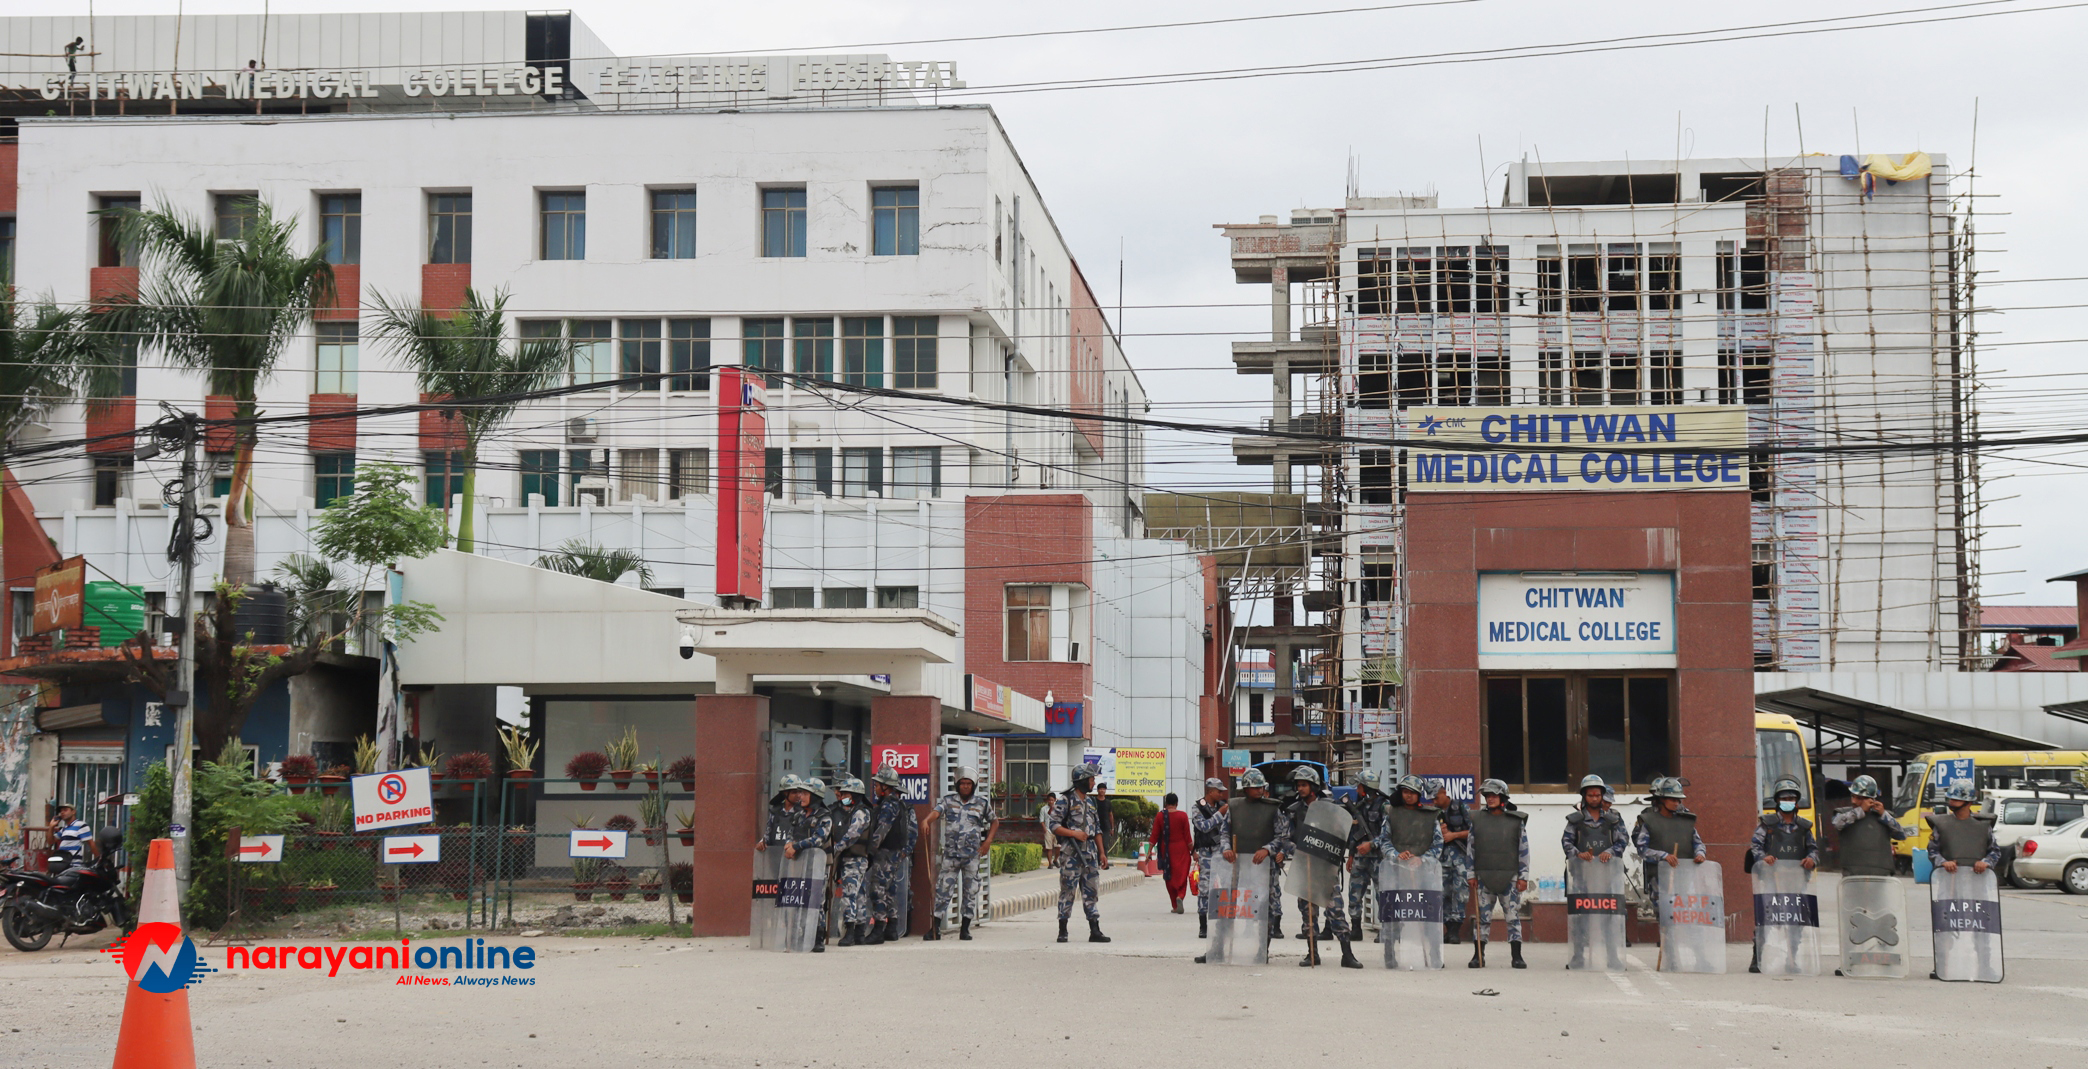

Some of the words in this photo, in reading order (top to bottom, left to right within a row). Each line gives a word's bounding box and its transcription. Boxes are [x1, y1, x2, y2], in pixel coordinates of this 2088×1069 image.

[225, 70, 379, 99] MEDICAL
[402, 66, 564, 98] COLLEGE
[793, 60, 967, 91] HOSPITAL
[1446, 418, 1466, 428] CMC
[1480, 414, 1676, 443] CHITWAN
[1416, 453, 1568, 484] MEDICAL
[1580, 453, 1741, 484] COLLEGE
[1525, 588, 1624, 609] CHITWAN
[1489, 621, 1571, 643] MEDICAL
[1579, 621, 1661, 641] COLLEGE
[882, 748, 919, 769] भित्र
[1116, 750, 1145, 759] OPENING
[1146, 751, 1165, 759] SOON
[1953, 760, 1969, 769] Staff
[1938, 763, 1947, 785] P
[1955, 768, 1967, 777] Car
[356, 814, 374, 825] NO
[376, 806, 431, 823] PARKING
[1303, 834, 1324, 849] ARMED
[1324, 842, 1342, 857] POLICE
[756, 884, 778, 894] POLIC
[782, 895, 805, 905] NEPAL
[1575, 898, 1617, 910] POLICE
[1217, 905, 1255, 918] NEPAL
[1394, 909, 1427, 919] NEPAL
[1673, 911, 1713, 924] NEPAL
[1771, 912, 1806, 923] NEPAL
[1950, 919, 1985, 930] NEPAL
